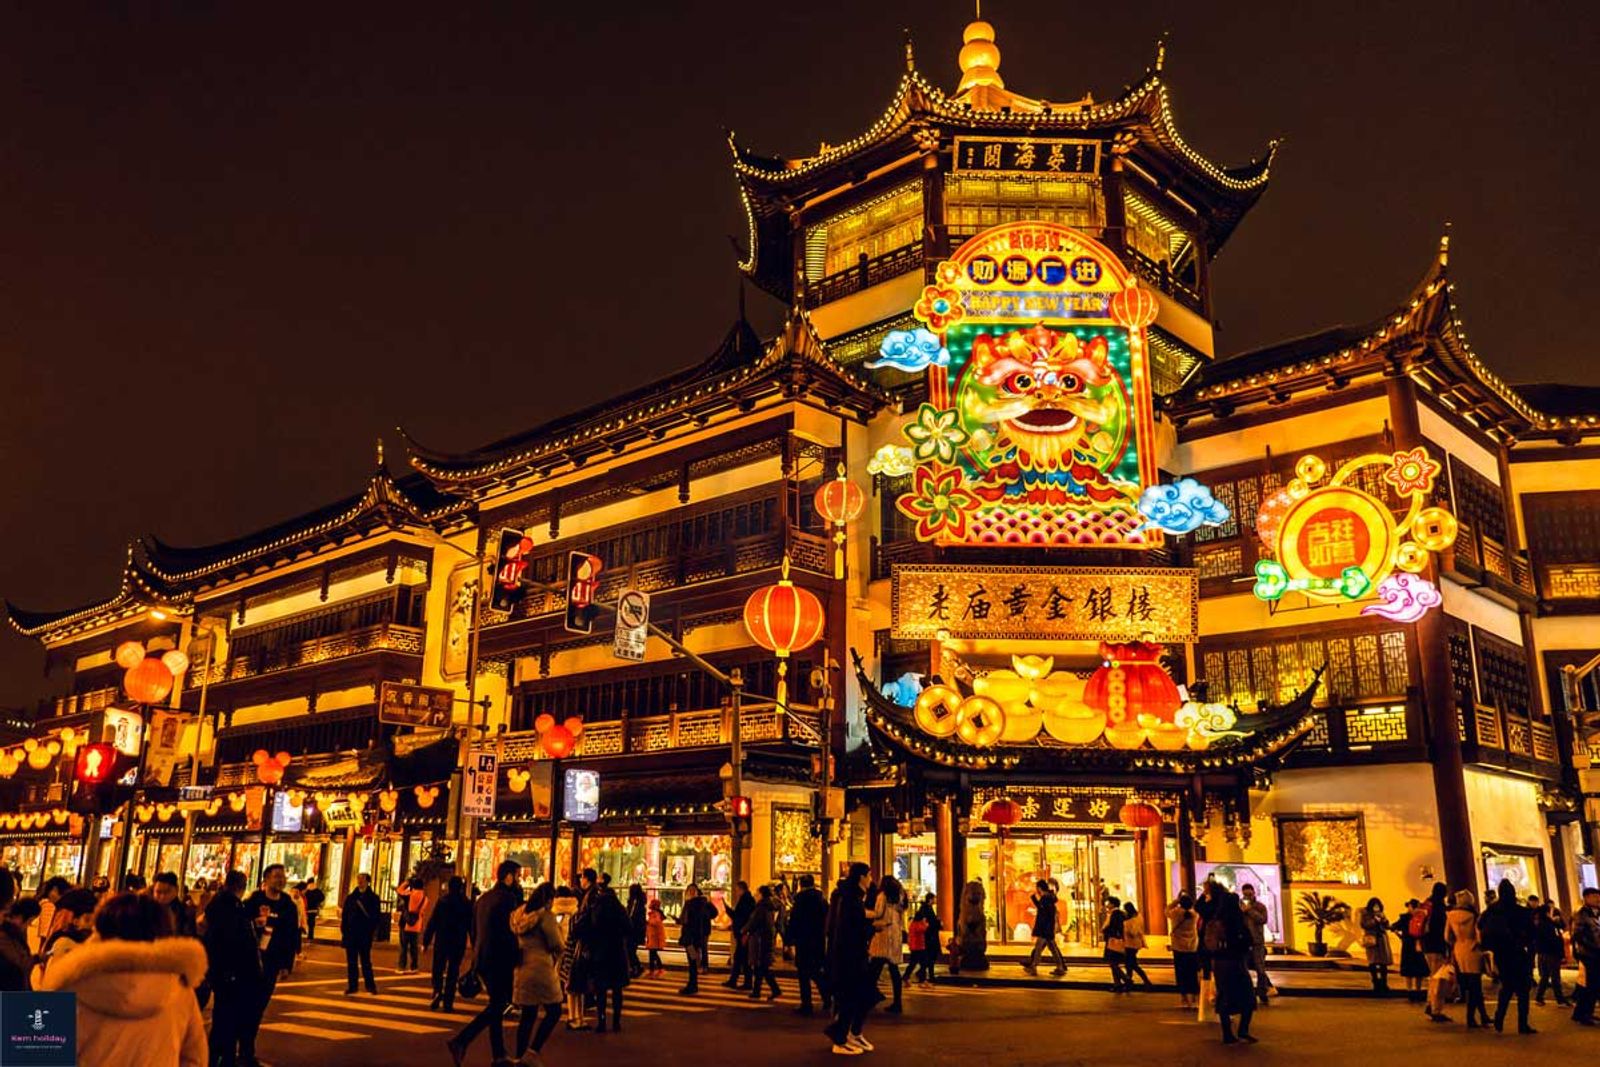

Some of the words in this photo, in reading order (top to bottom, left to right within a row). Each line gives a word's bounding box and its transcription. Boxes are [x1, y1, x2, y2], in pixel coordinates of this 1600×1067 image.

[972, 260, 1097, 282] 财源广进
[969, 295, 1020, 311] HAPPY
[1024, 295, 1059, 311] NEW
[1063, 296, 1103, 311] YEAR
